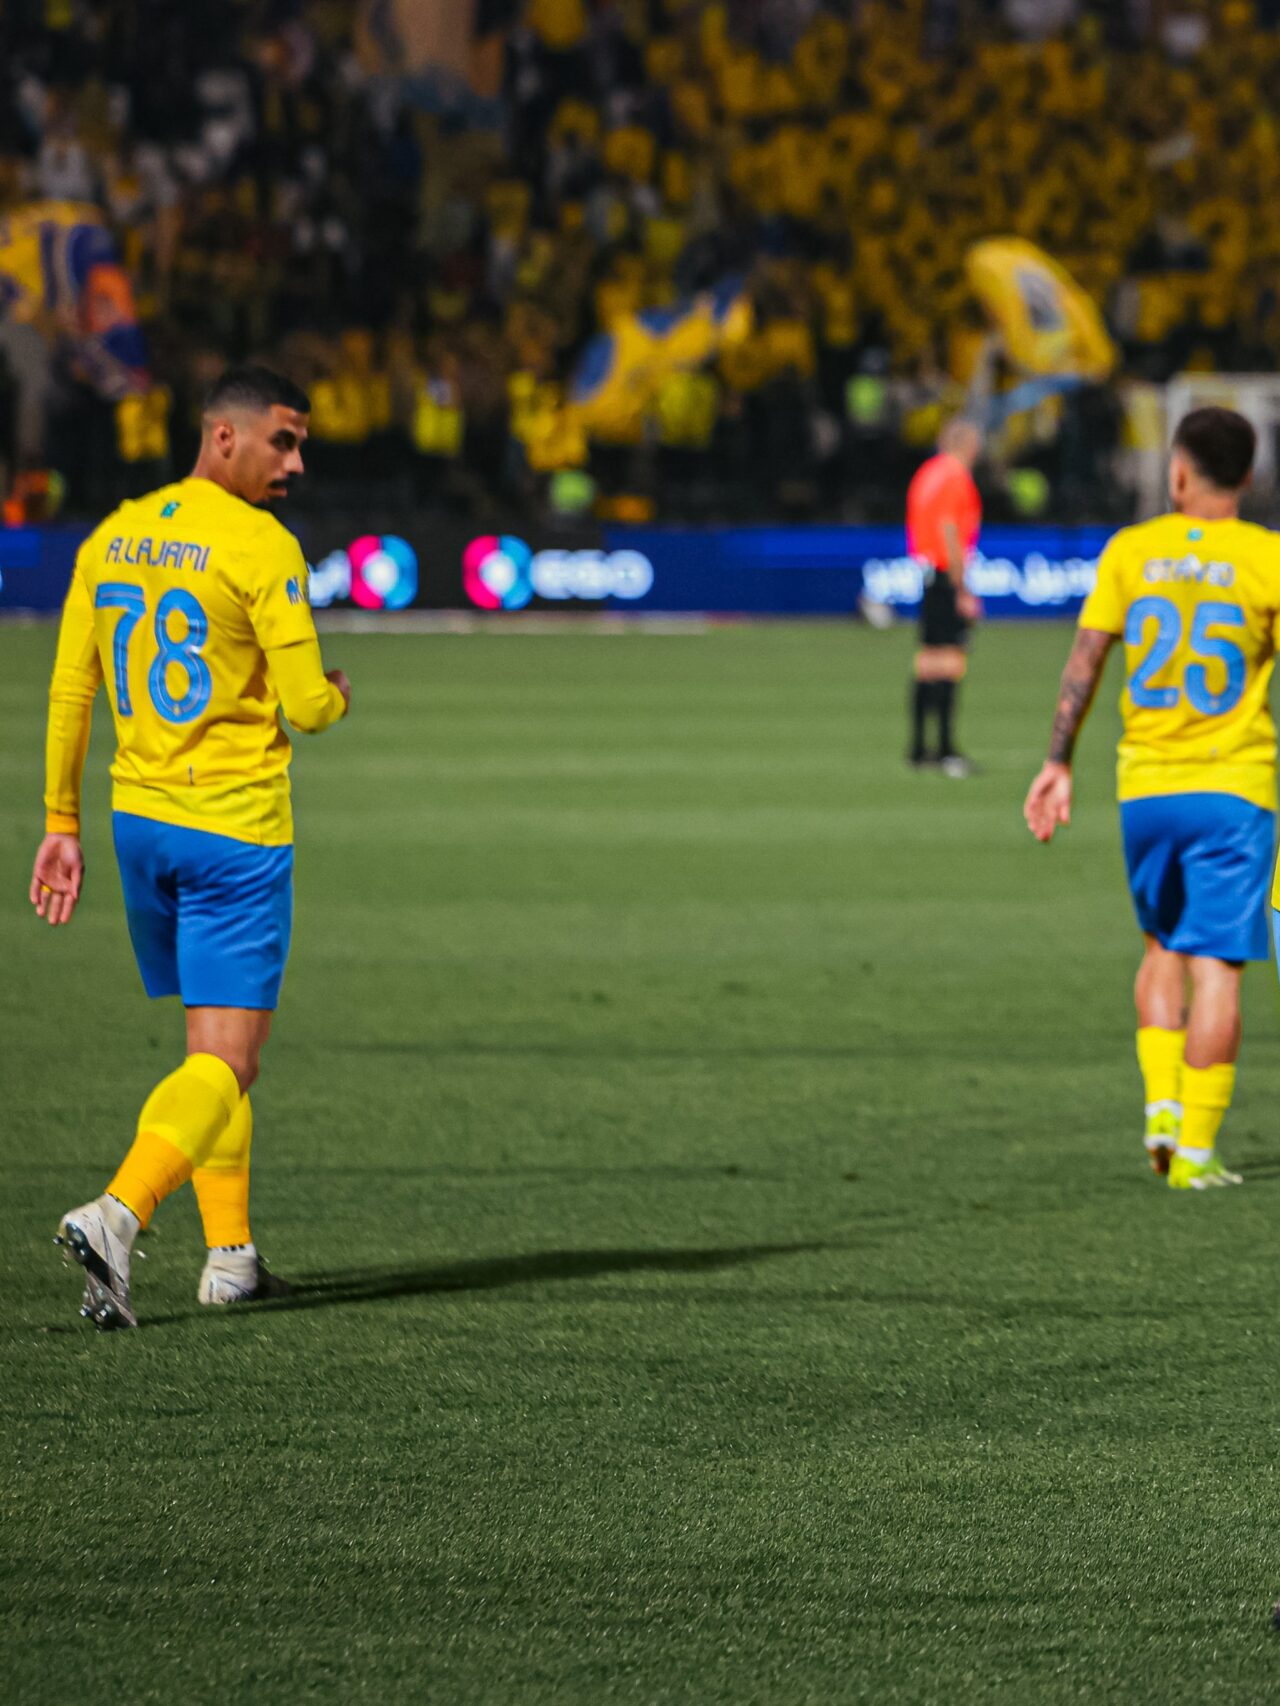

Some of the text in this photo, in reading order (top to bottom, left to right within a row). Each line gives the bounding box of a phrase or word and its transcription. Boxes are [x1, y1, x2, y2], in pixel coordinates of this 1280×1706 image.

[106, 537, 210, 571] A.LAJAMI
[95, 581, 212, 724] 78
[1125, 595, 1247, 716] 25
